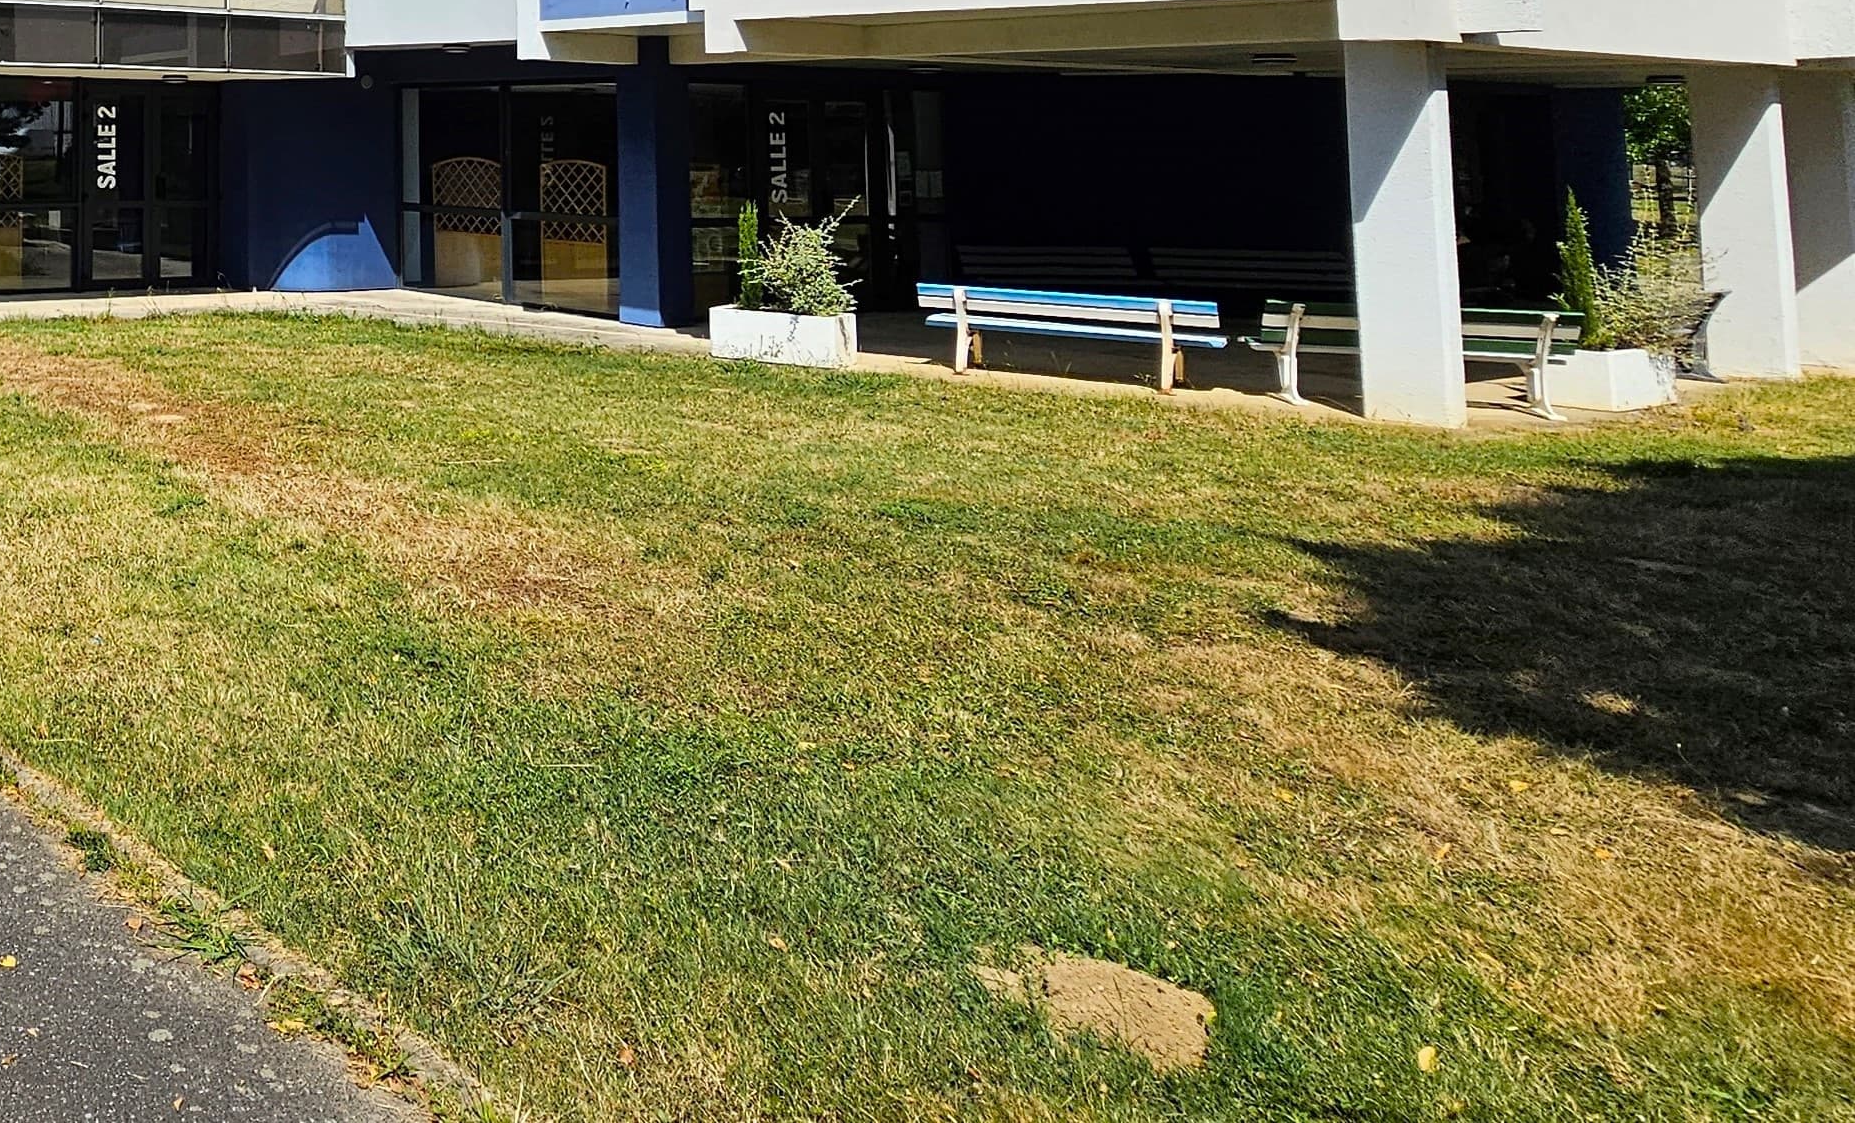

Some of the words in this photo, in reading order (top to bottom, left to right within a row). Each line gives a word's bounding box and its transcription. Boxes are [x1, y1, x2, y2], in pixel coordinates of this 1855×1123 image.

[97, 106, 116, 119] 2
[768, 112, 785, 125] 2
[97, 124, 116, 190] SALLE
[769, 132, 788, 204] SALLE
